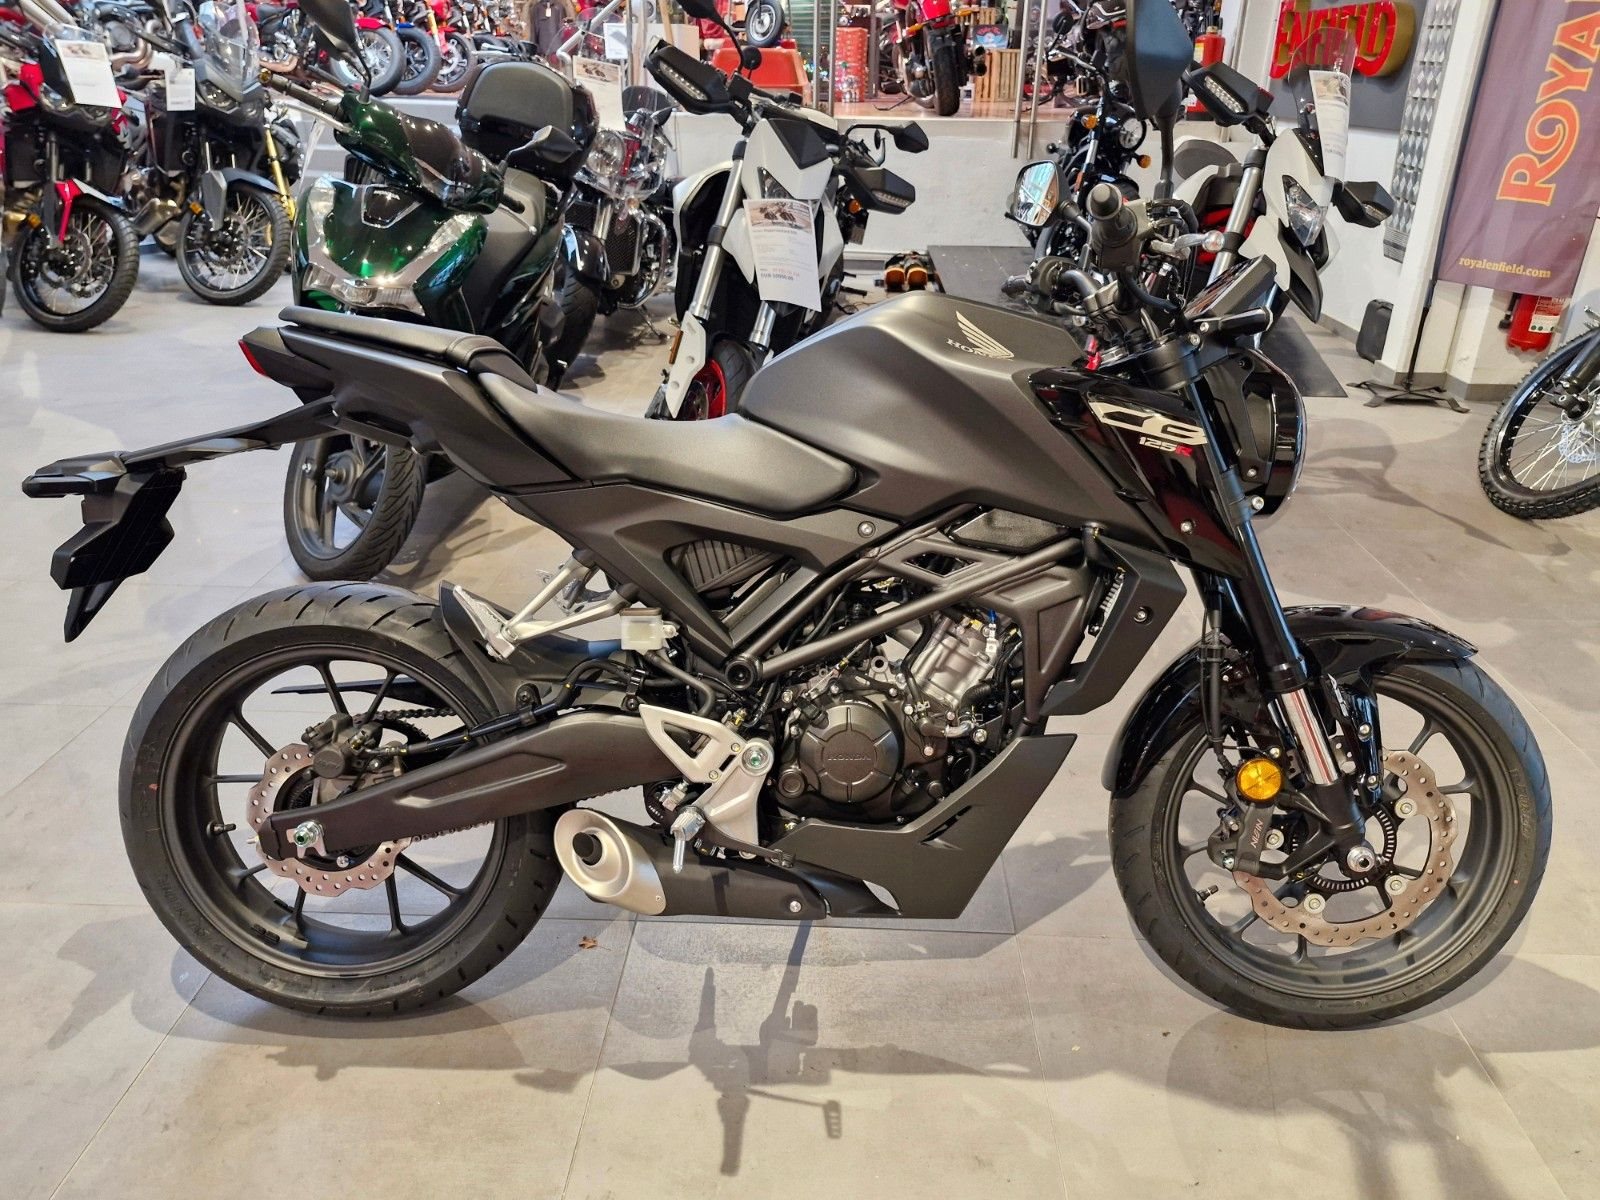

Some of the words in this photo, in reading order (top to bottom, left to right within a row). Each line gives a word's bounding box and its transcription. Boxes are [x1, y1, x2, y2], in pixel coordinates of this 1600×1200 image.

[1496, 0, 1600, 207] ROYA
[1458, 256, 1552, 279] royalenfield.com
[1139, 436, 1193, 457] 125R
[827, 753, 872, 761] HONDA
